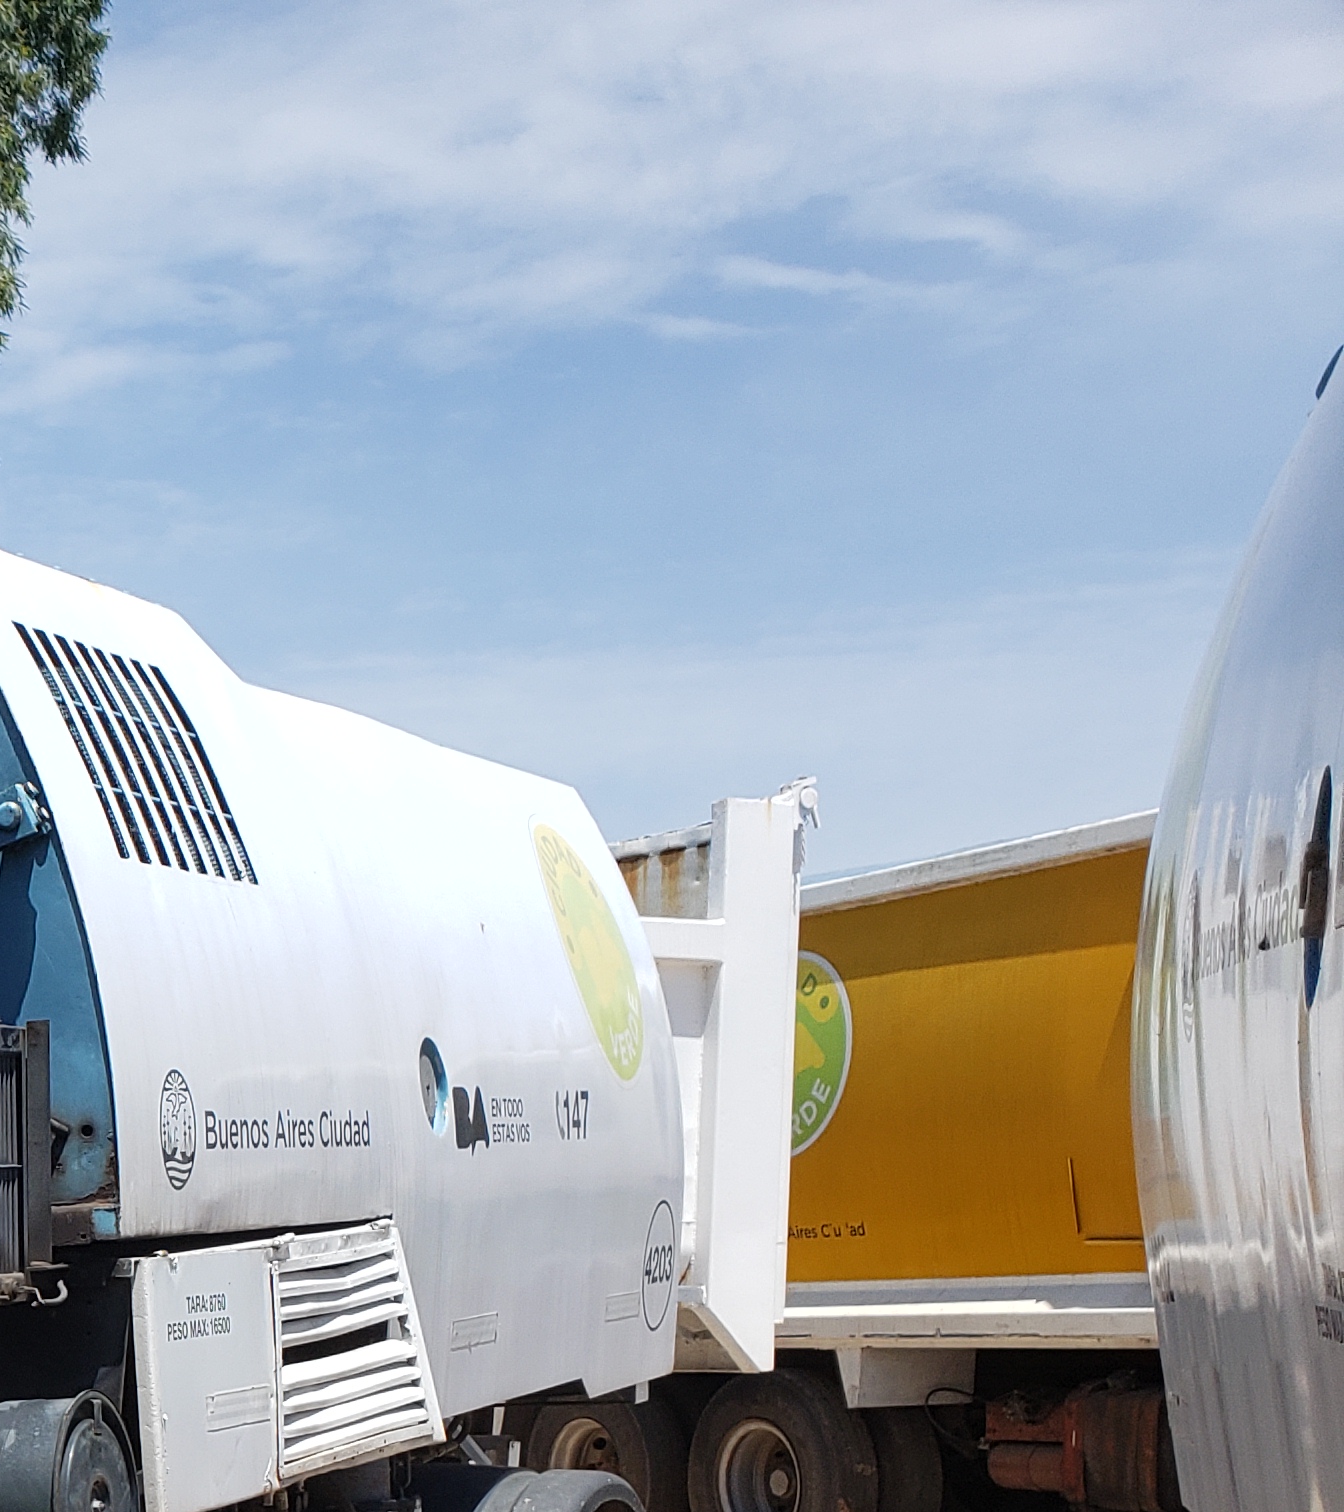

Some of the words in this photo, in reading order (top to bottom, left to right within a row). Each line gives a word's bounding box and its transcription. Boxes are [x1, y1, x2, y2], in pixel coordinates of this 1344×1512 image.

[452, 1086, 489, 1157] BA
[491, 1098, 502, 1117] EN
[502, 1098, 524, 1117] TODO
[563, 1090, 589, 1140] 147
[204, 1110, 269, 1149] Buenos
[274, 1109, 315, 1148] Aires
[319, 1109, 371, 1147] Ciudad
[492, 1124, 515, 1143] ESTAS
[516, 1123, 530, 1142] VOS
[645, 1245, 672, 1284] 4203
[167, 1321, 188, 1342] PESO
